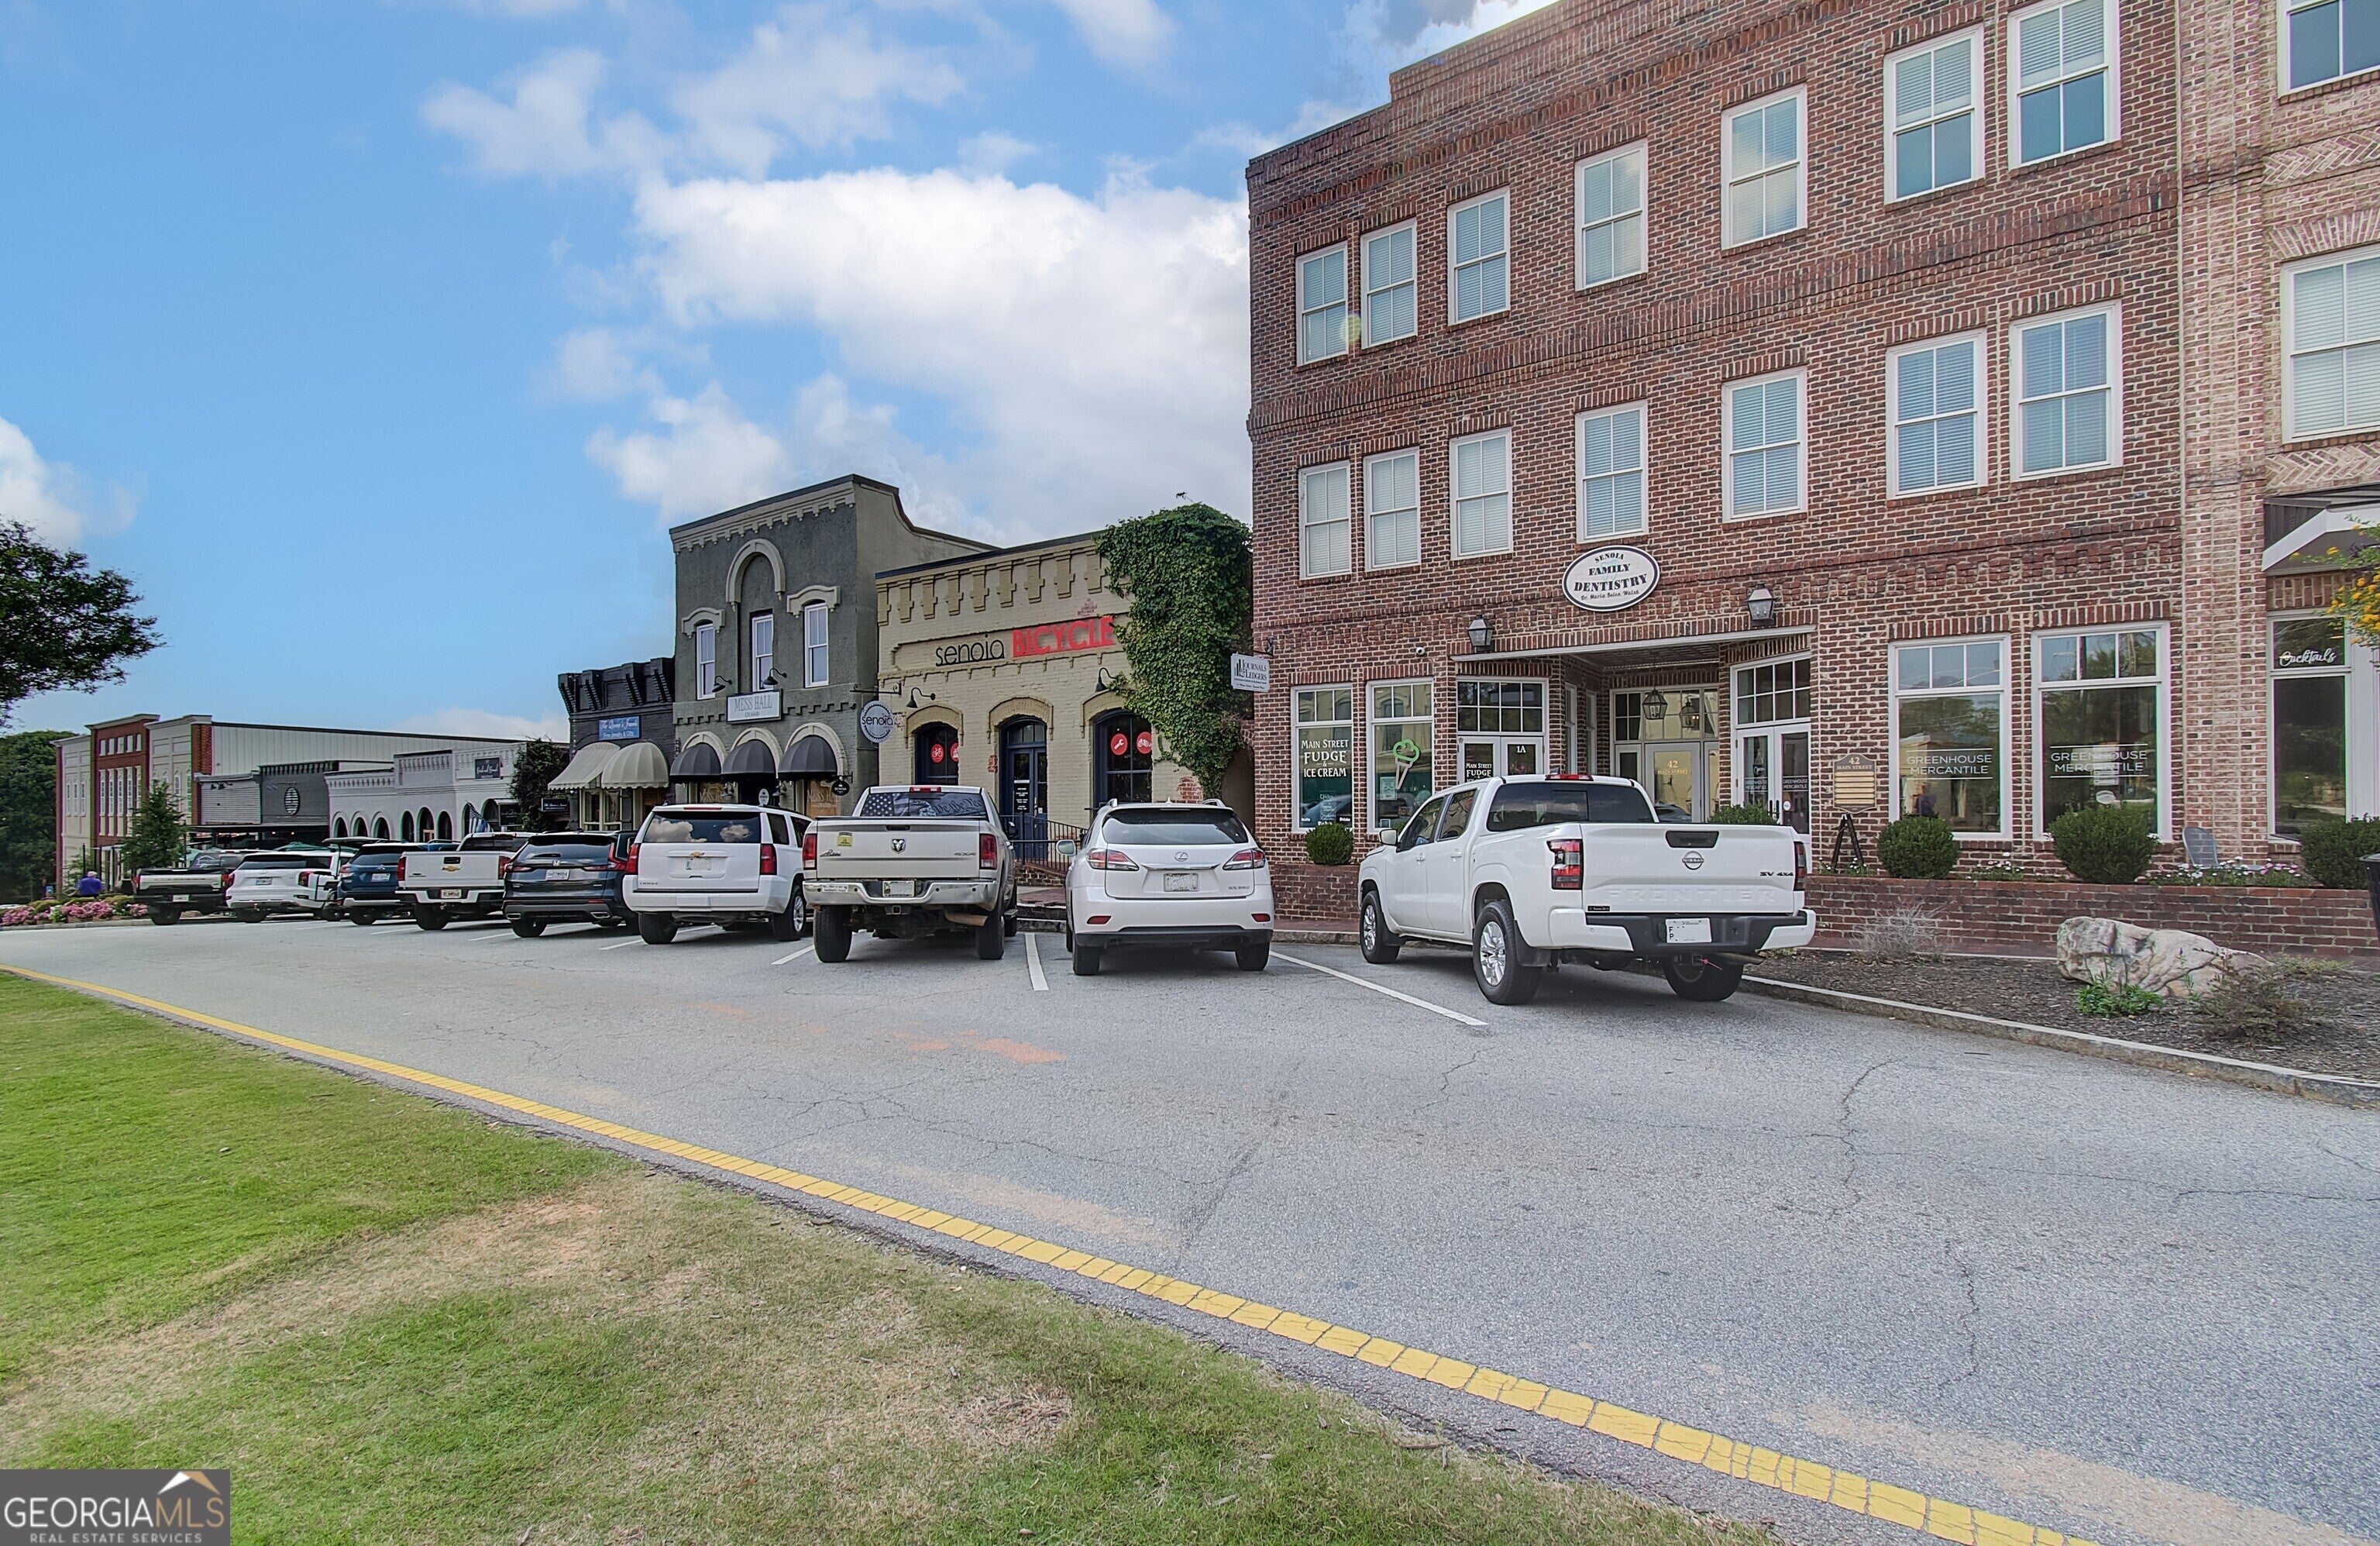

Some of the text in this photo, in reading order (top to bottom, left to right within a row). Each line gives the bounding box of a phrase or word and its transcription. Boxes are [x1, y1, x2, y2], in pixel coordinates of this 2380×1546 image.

[1594, 553, 1624, 563] SENOIA
[1588, 563, 1631, 576] FAMILY
[1573, 573, 1647, 591] DENTISTRY
[935, 615, 1114, 666] senoia BICYCLE
[2279, 648, 2337, 666] Cocktails
[1242, 659, 1267, 672] JOURNALS
[1246, 669, 1267, 680] LEDGERS
[734, 695, 772, 711] MESS HALL
[862, 713, 893, 725] senoia
[1302, 739, 1349, 749] MAIN STREET
[1304, 751, 1346, 765] FUDGE
[1849, 756, 1860, 765] 42
[1907, 755, 1992, 764] GREENHOUSE
[2051, 751, 2148, 761] GREEOUSE
[1304, 768, 1346, 777] ICE CREAM
[1910, 766, 1989, 775] MERCANTILE
[2055, 763, 2144, 772] MERCTILE
